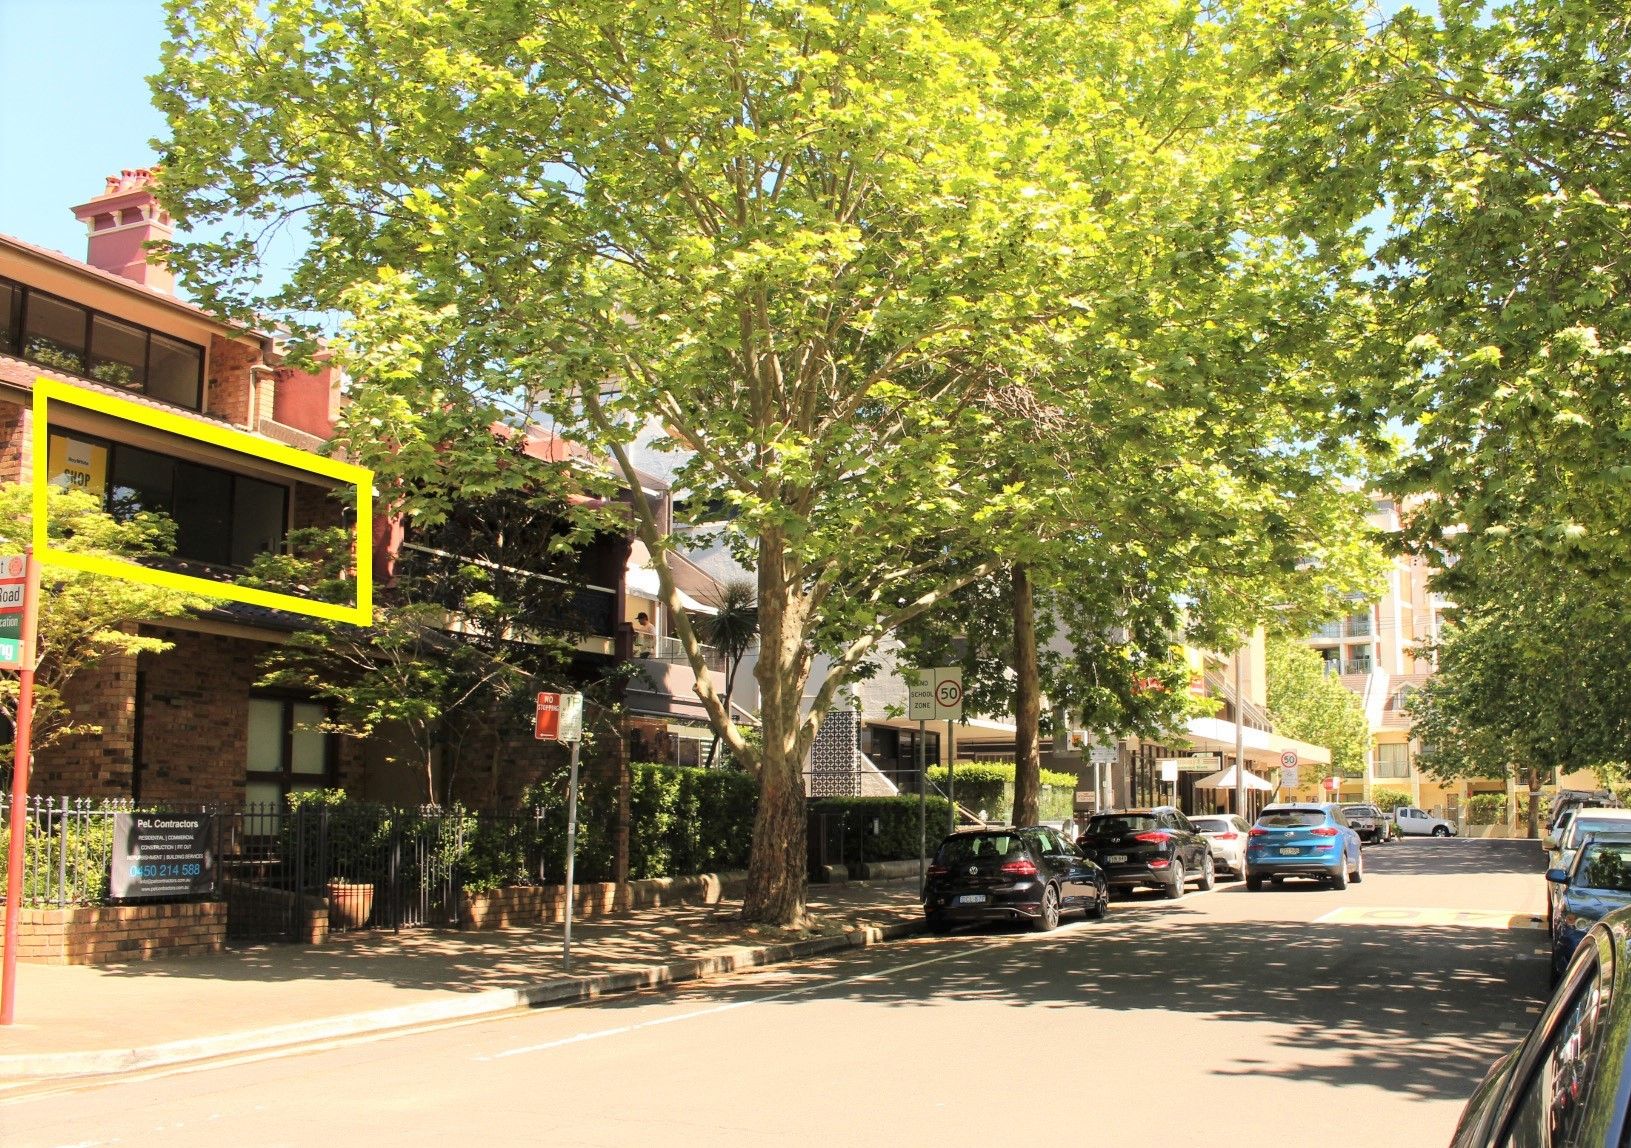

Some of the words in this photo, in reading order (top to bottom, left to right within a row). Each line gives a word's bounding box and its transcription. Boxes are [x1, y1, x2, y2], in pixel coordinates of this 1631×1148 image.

[64, 469, 91, 486] SHOP
[941, 687, 957, 700] 50
[544, 695, 554, 704] NO
[1284, 755, 1295, 764] 50
[137, 819, 153, 828] PeL
[154, 819, 199, 828] Contractors
[128, 864, 157, 877] 0450
[159, 864, 179, 876] 214
[181, 863, 200, 875] 588
